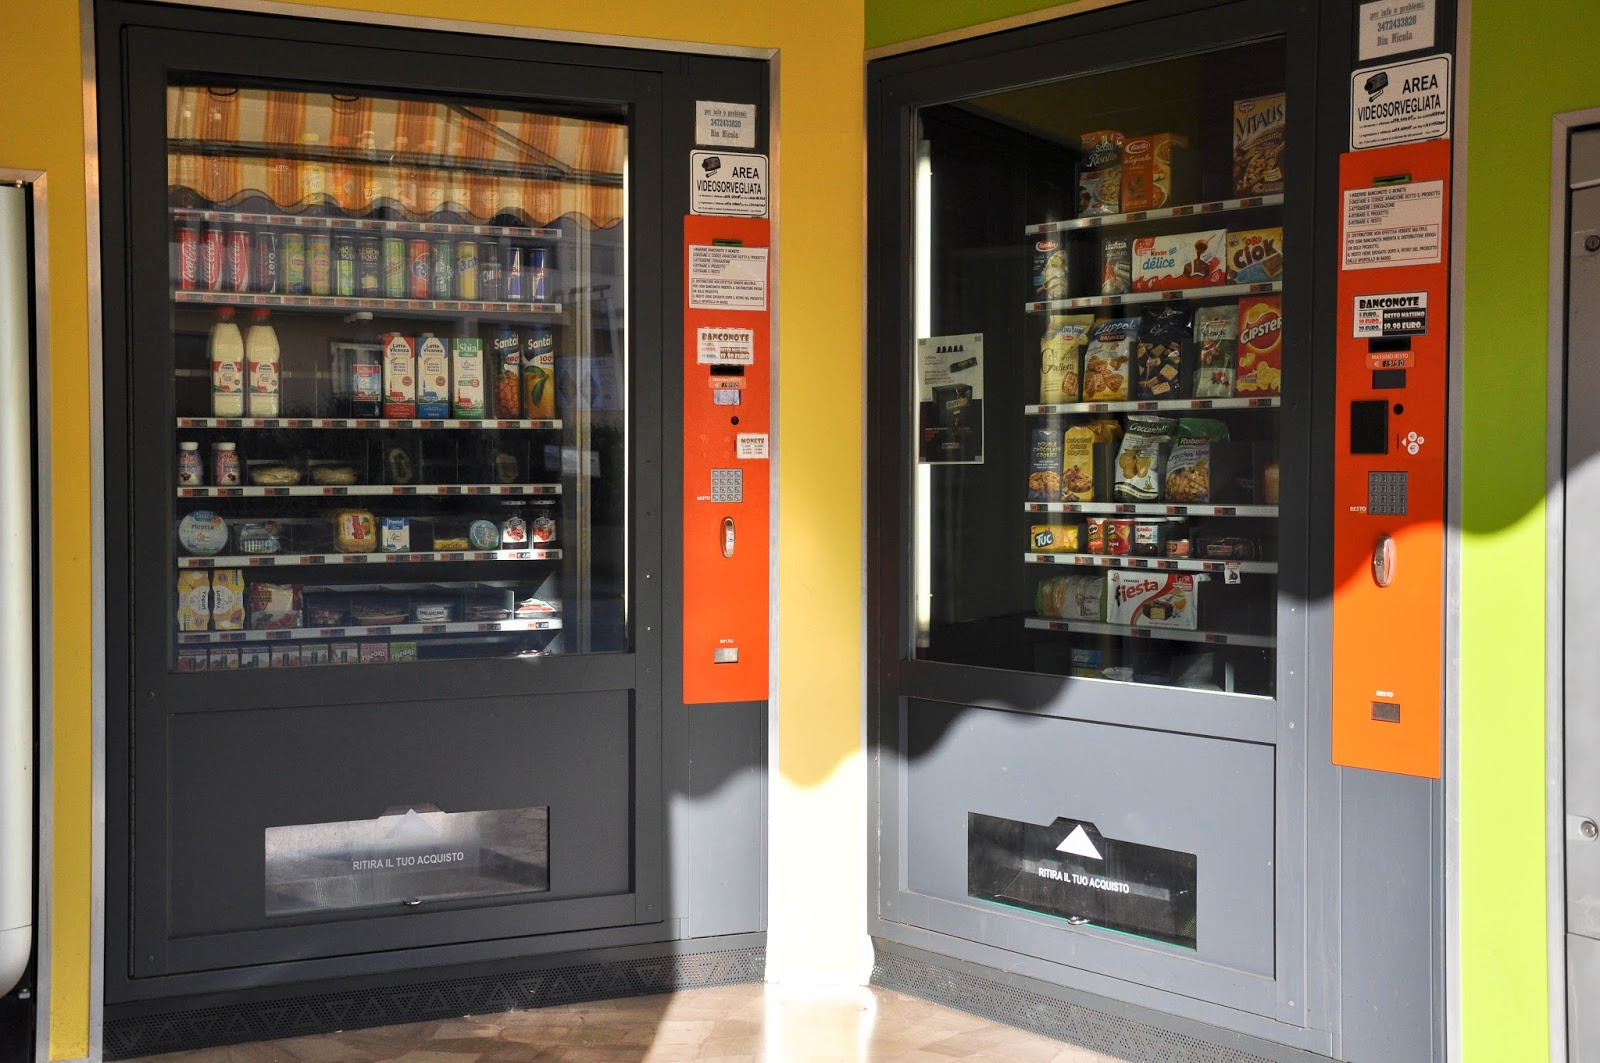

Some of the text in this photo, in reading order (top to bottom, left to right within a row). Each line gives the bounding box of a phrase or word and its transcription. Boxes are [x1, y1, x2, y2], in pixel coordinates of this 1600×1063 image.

[1377, 15, 1416, 32] 3472433820
[1391, 31, 1413, 43] Nicola
[1402, 74, 1438, 94] AREA
[1358, 94, 1441, 121] VIDEOSORVEGLIATA
[1236, 103, 1283, 135] VITALIS
[722, 130, 738, 138] Nicola
[732, 166, 759, 179] AREA
[697, 180, 761, 194] VIDEOSORVEGLIATA
[1233, 239, 1278, 269] CIOK
[1360, 296, 1419, 309] BANCONOTE
[494, 334, 519, 350] Santal
[528, 334, 553, 350] Santal
[702, 333, 749, 341] BANCONOTE
[1035, 532, 1053, 547] TUC
[1115, 579, 1159, 607] fiesta
[352, 851, 464, 871] RITIRA IL TUO ACQUISTO
[1038, 867, 1130, 894] RITIRA IL TUO ACQUISTO
